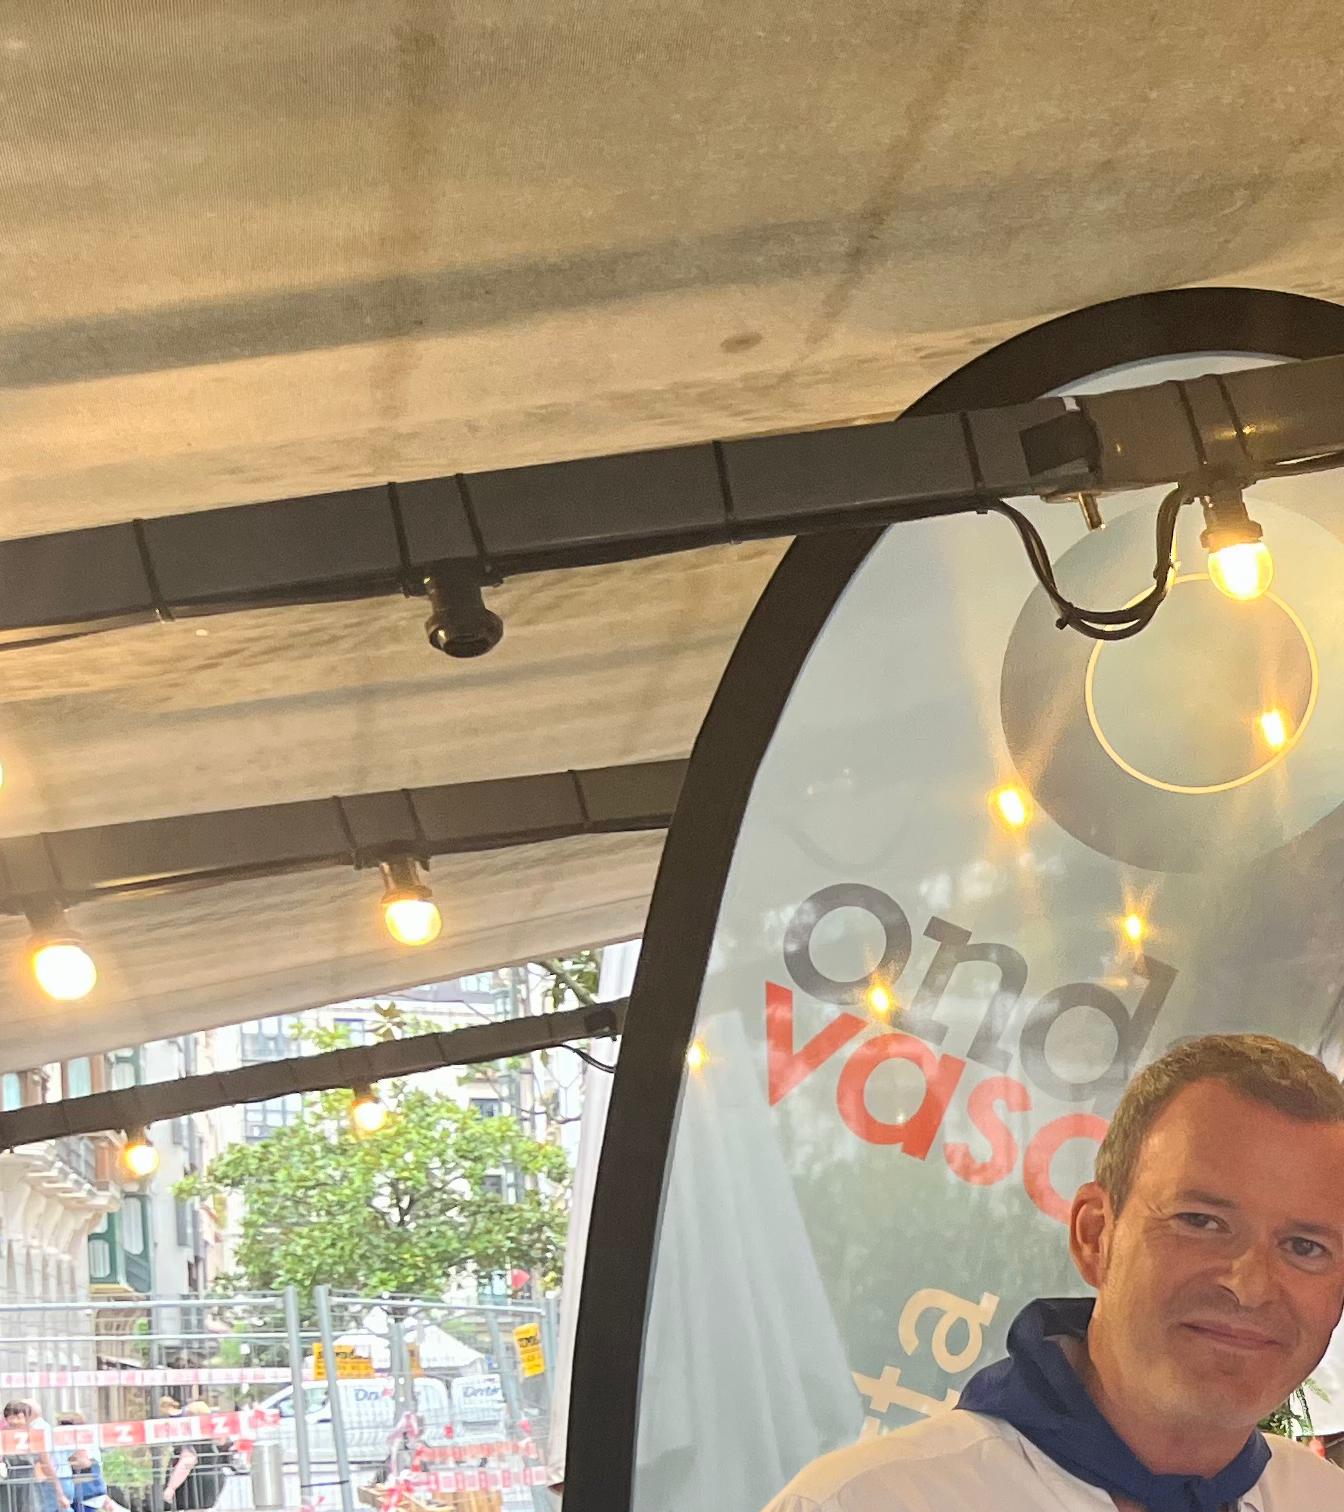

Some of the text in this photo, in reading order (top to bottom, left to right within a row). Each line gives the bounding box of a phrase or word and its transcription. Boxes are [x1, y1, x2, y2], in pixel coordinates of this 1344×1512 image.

[764, 980, 1110, 1226] vasc
[783, 882, 1200, 1112] ond
[852, 1287, 1000, 1438] ta
